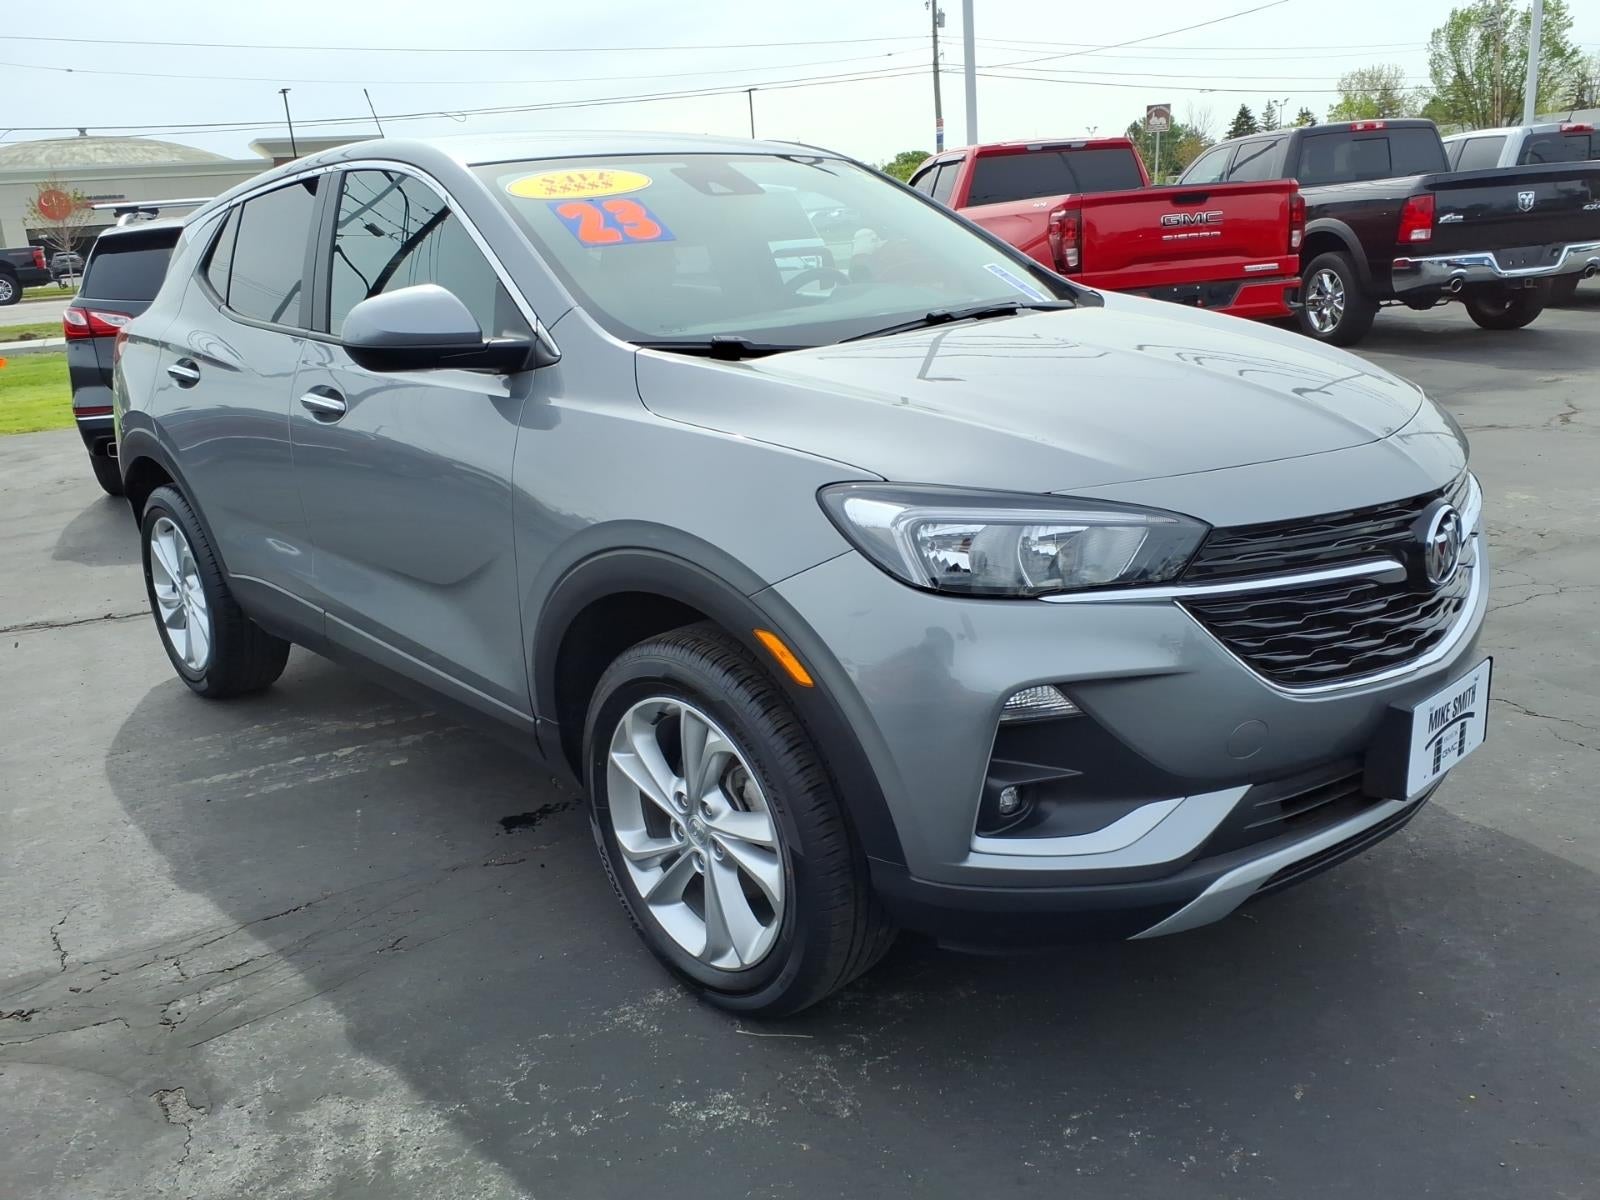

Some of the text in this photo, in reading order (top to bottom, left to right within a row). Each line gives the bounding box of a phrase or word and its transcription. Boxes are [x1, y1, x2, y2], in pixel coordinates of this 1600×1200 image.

[555, 199, 662, 244] 23
[1160, 210, 1224, 228] GMC
[1428, 683, 1477, 734] MIKE SMITH
